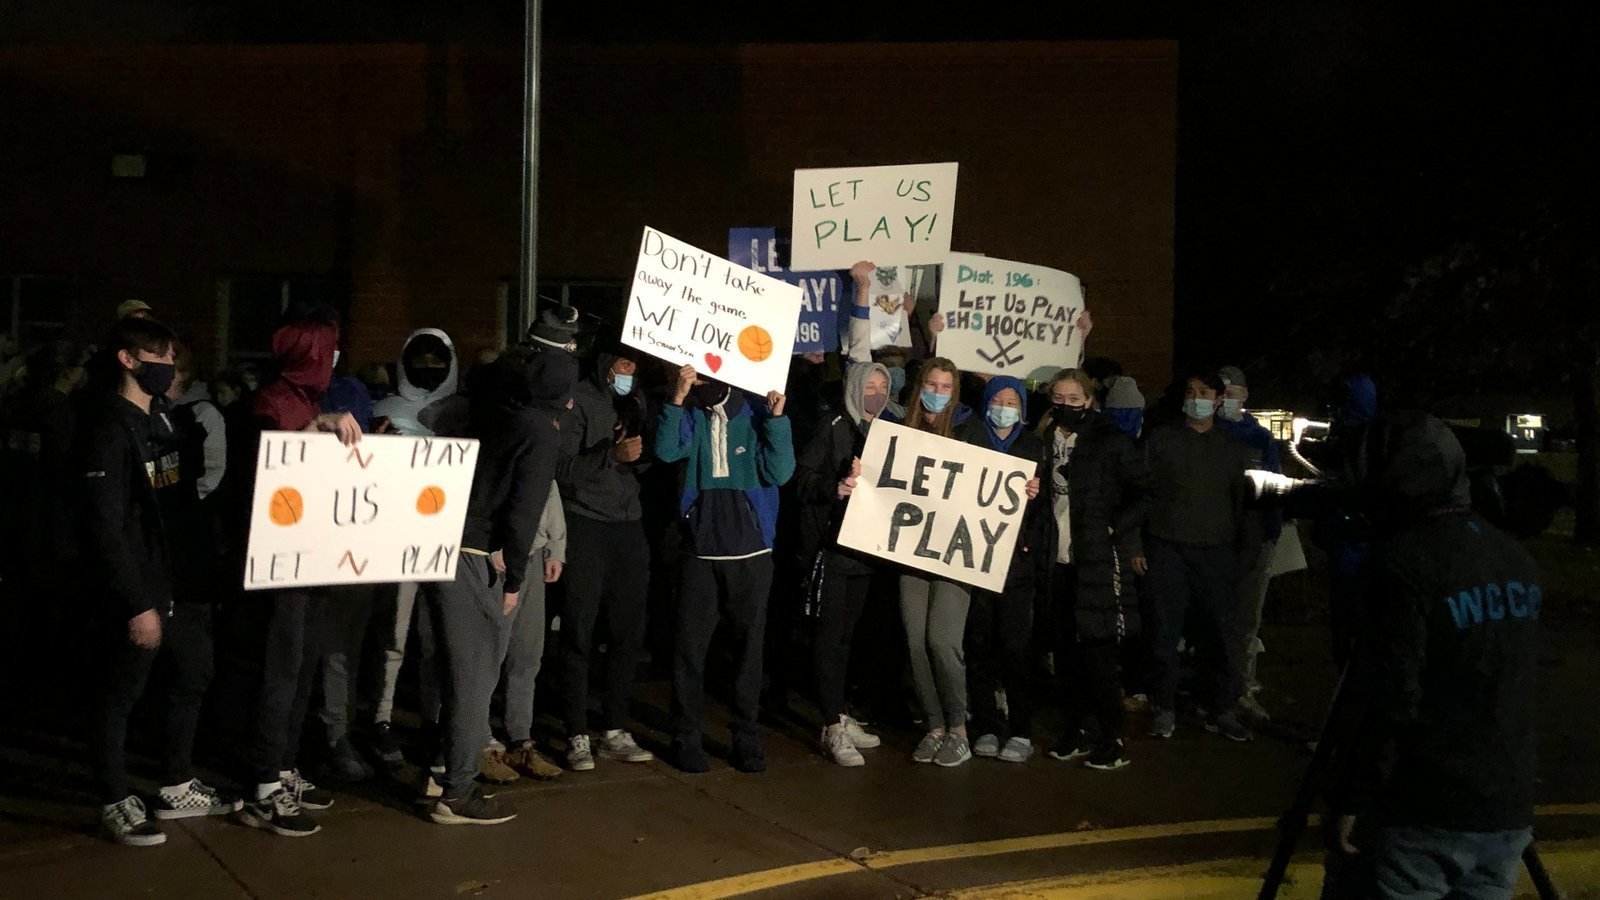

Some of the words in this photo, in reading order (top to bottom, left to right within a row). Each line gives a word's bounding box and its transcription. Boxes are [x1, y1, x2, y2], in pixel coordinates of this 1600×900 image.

[809, 179, 863, 208] LET
[896, 178, 931, 202] US
[814, 212, 938, 250] PLAY!
[643, 230, 712, 279] Don't
[725, 266, 766, 296] take
[637, 270, 673, 296] away
[681, 285, 703, 305] the
[636, 295, 682, 332] WE
[690, 317, 735, 352] LOVE
[985, 315, 1075, 347] HOCKEY!
[265, 439, 312, 470] LET
[411, 437, 471, 469] PLAY
[333, 483, 379, 527] US
[976, 467, 1027, 516] US
[887, 501, 1009, 574] PLAY
[250, 551, 312, 584] LET
[401, 544, 455, 575] PLAY
